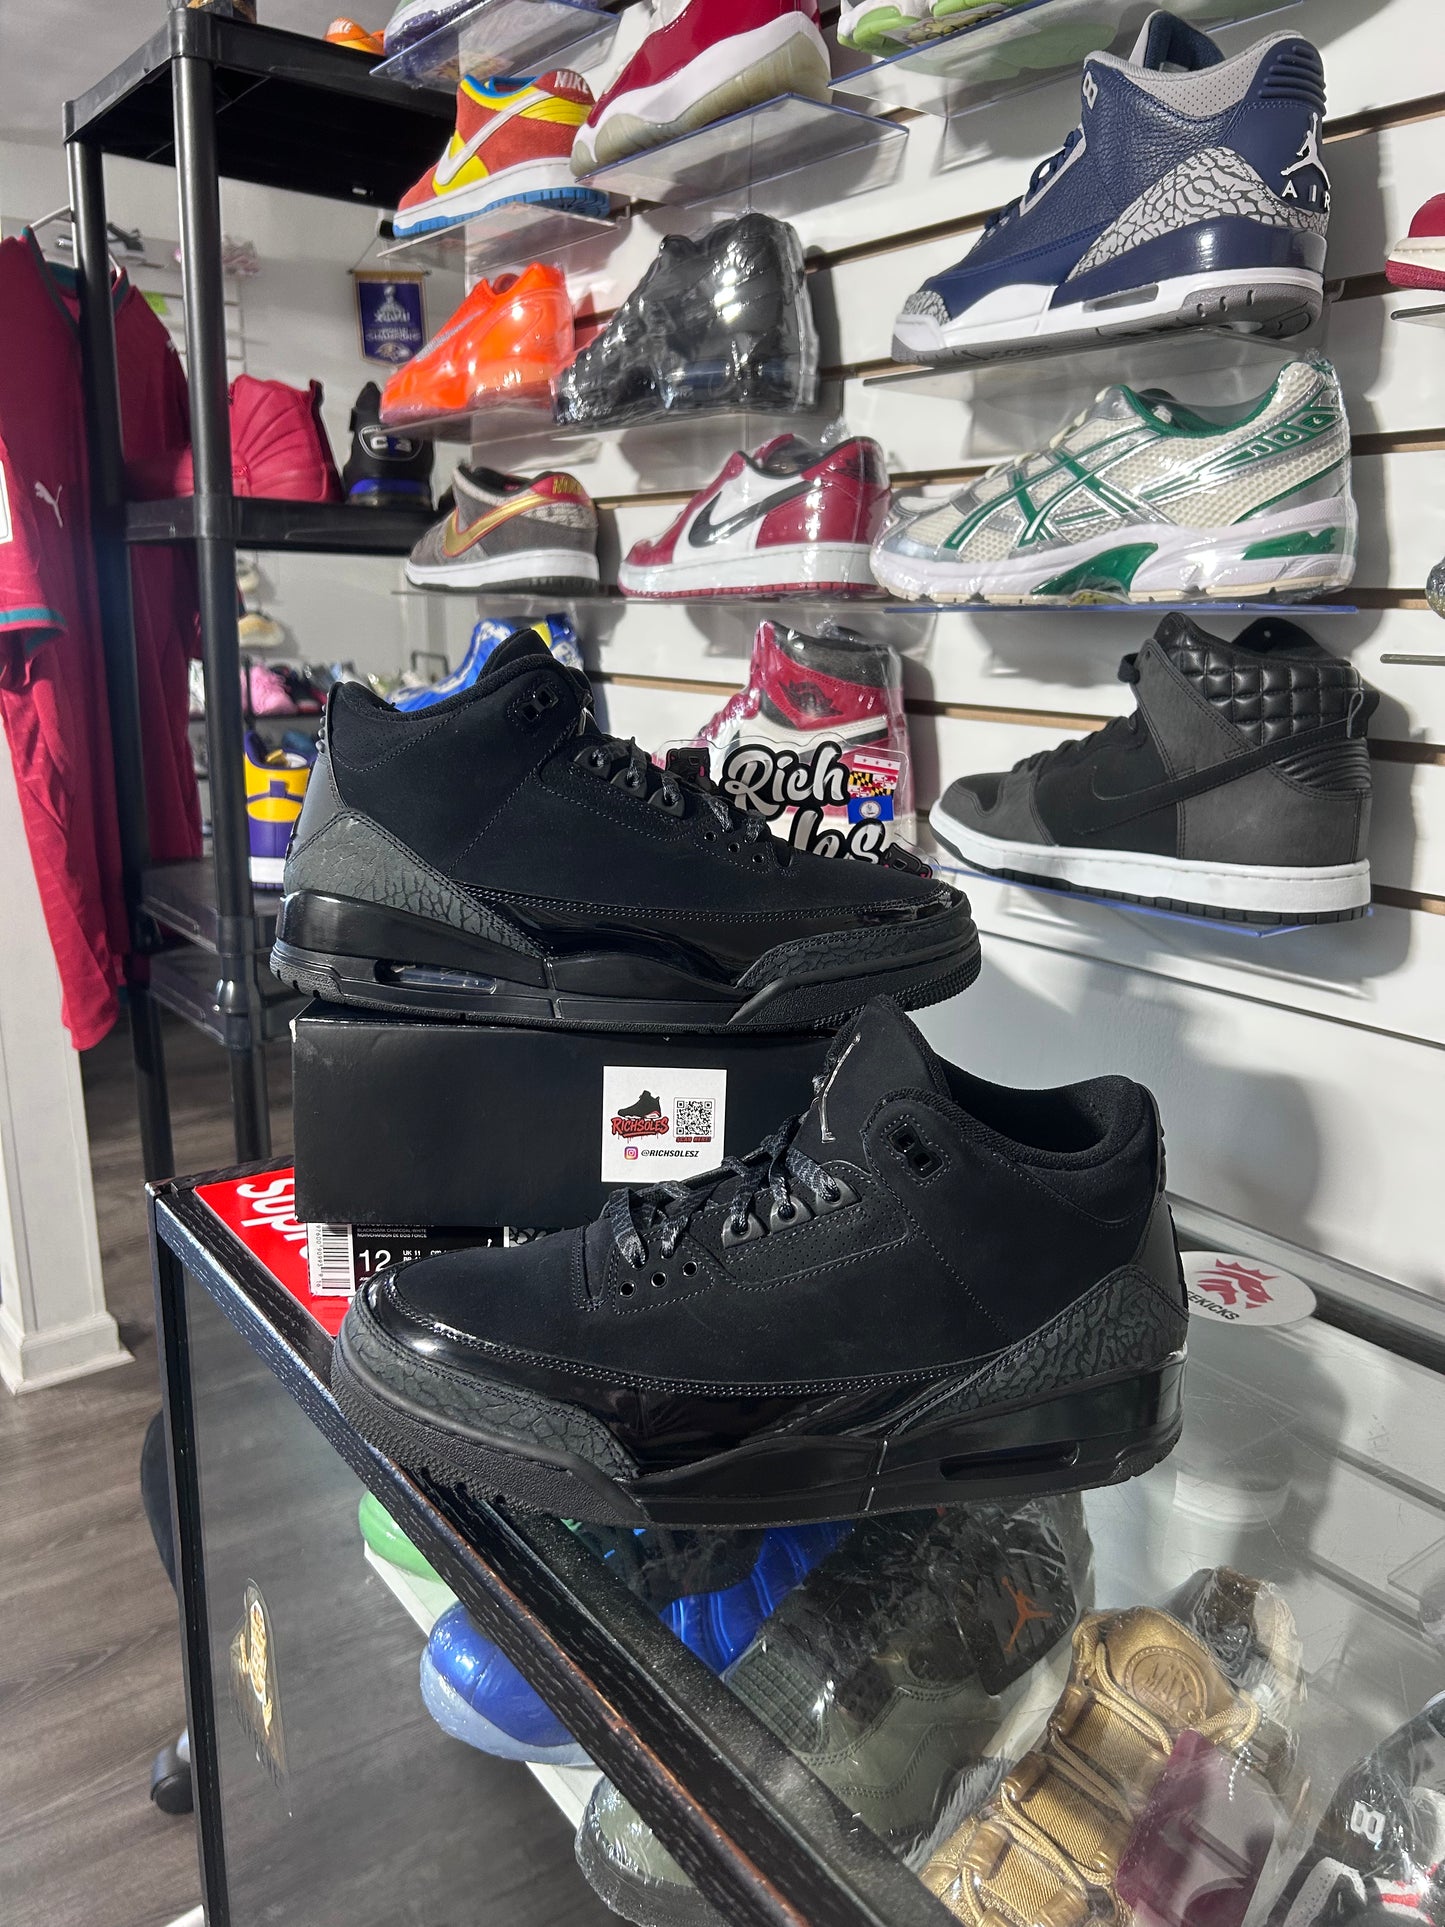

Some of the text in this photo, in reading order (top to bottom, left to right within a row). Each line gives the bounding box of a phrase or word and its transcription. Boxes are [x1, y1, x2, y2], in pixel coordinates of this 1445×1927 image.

[554, 71, 589, 94] NIKE
[1281, 180, 1331, 211] AIR
[723, 746, 845, 817] Rich
[611, 1116, 669, 1137] RICHSOLES
[641, 1149, 699, 1158] @RICHSOLESZ
[359, 1249, 392, 1272] 12
